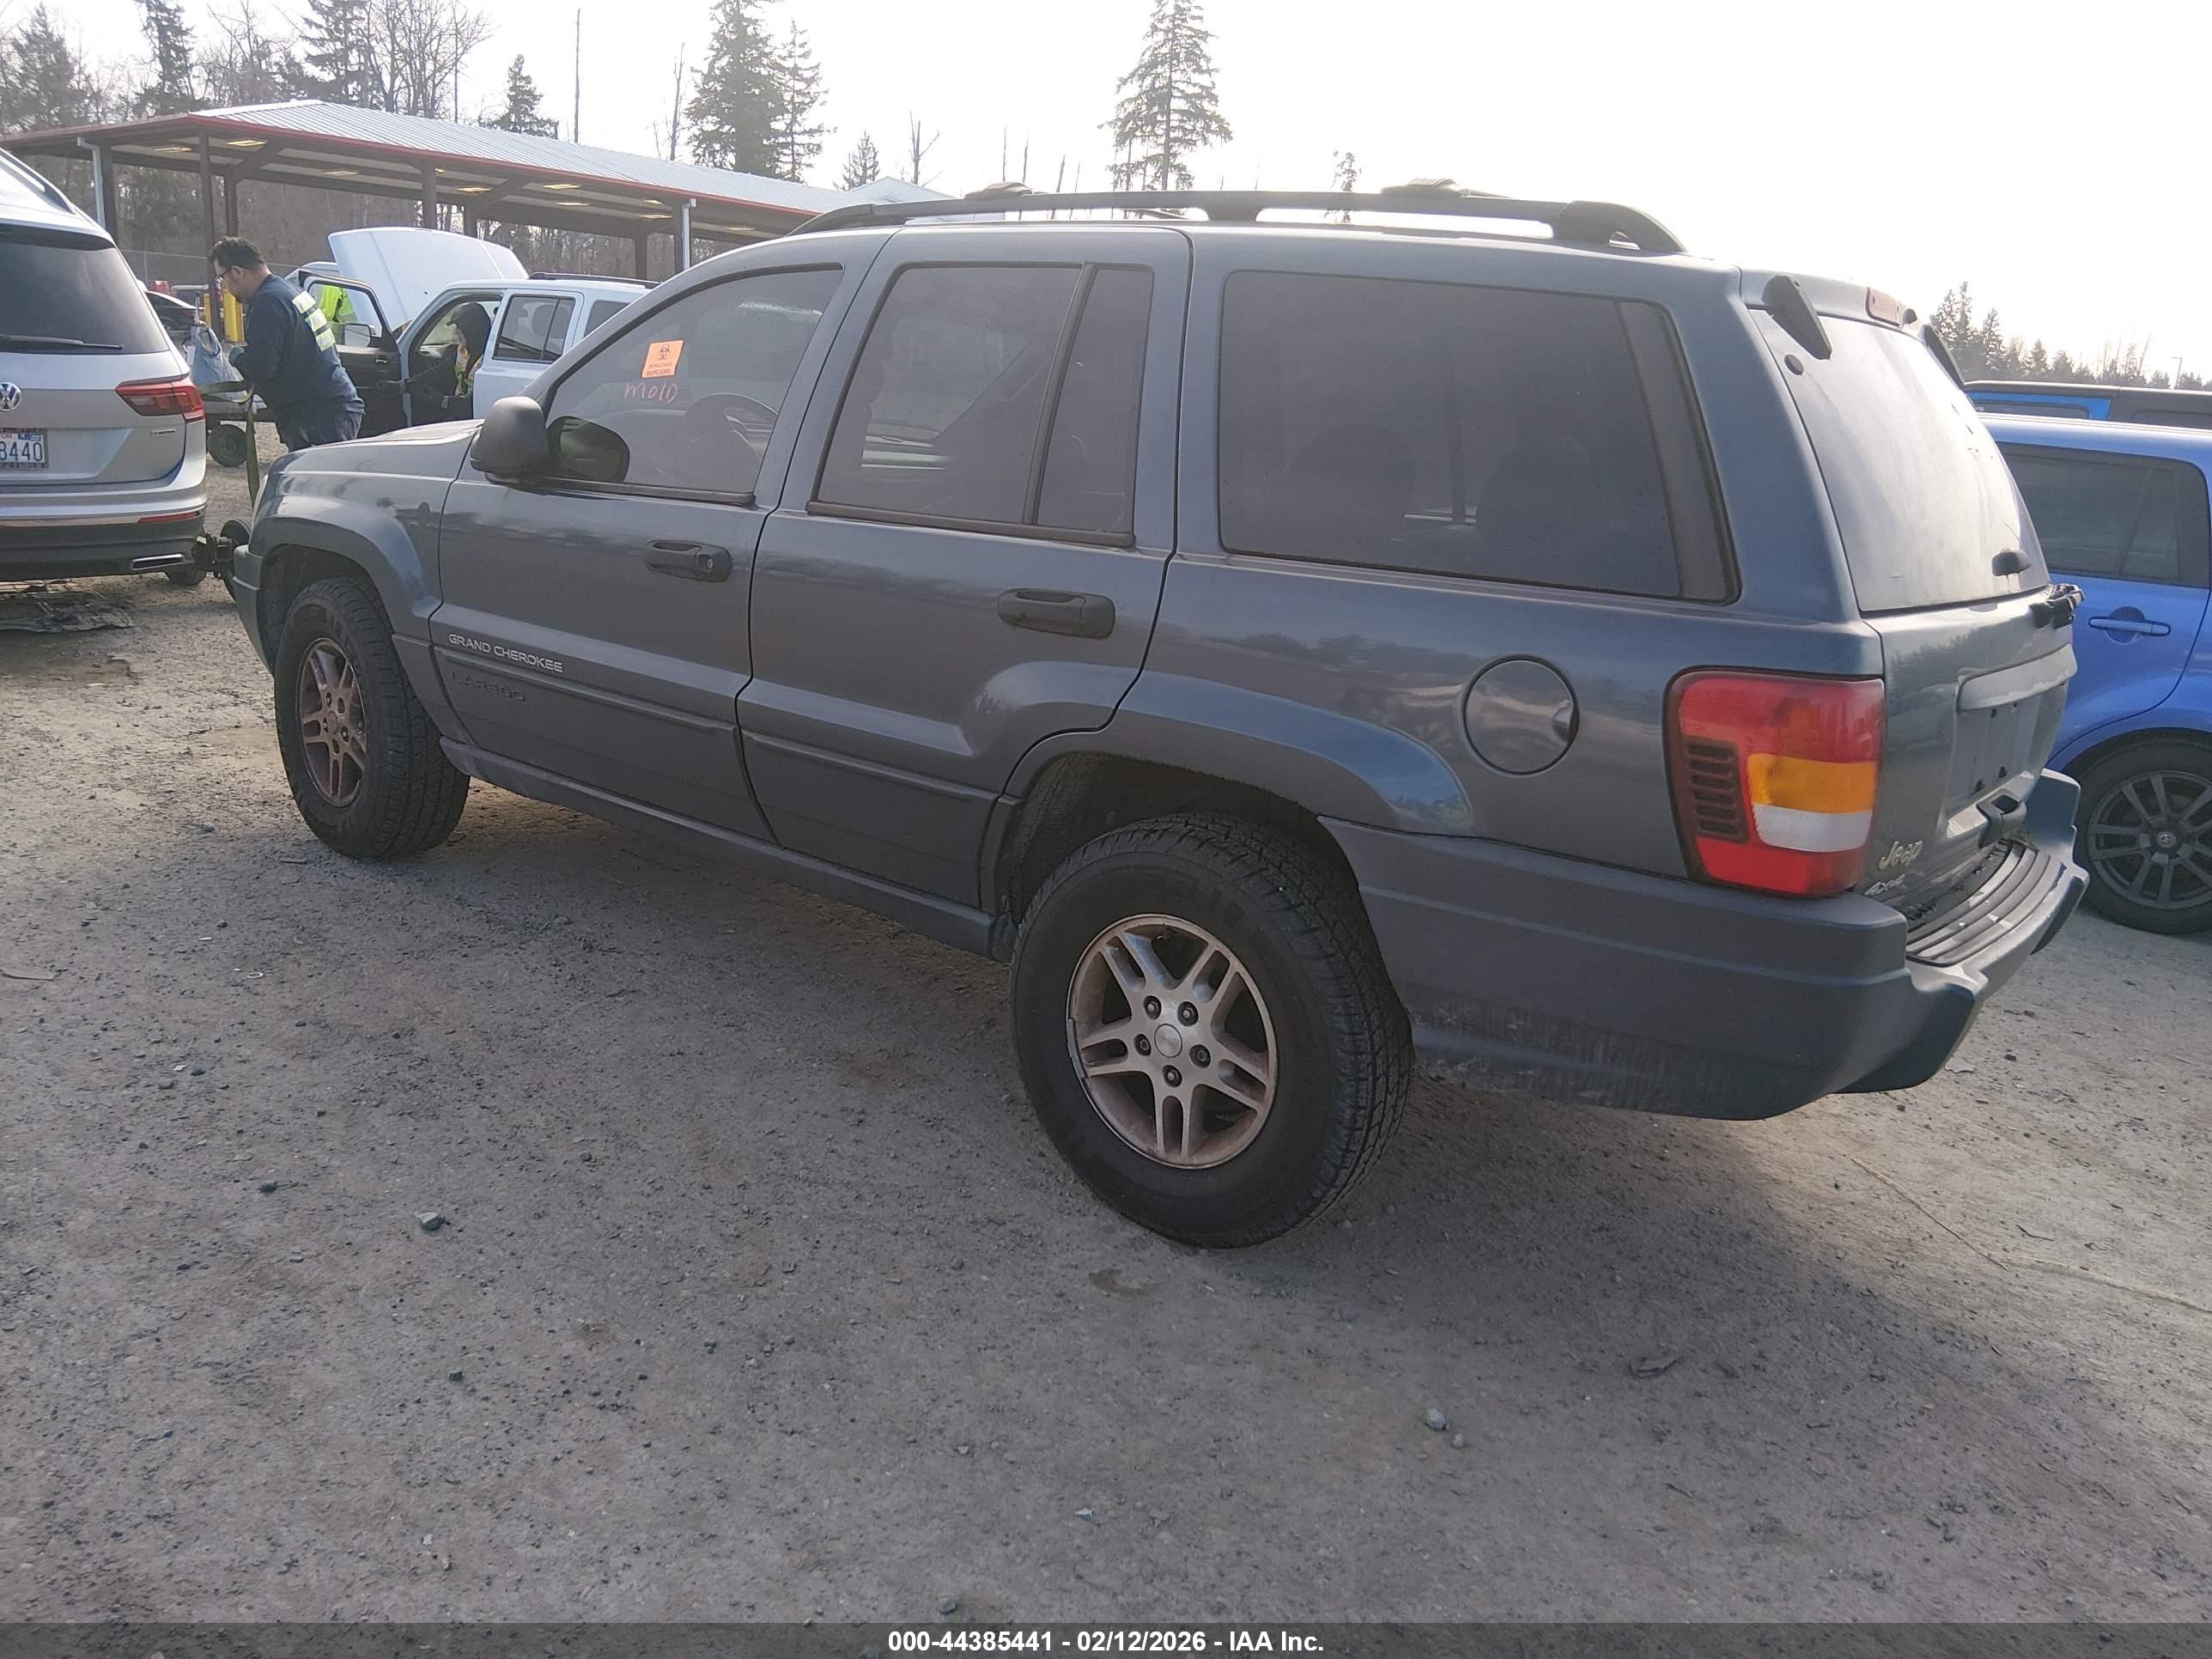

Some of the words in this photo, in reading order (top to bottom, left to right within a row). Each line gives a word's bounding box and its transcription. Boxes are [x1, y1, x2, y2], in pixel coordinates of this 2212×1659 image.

[448, 634, 491, 653] GRAND
[494, 646, 563, 672] CHEROKEE
[1878, 840, 1923, 870] Jeep
